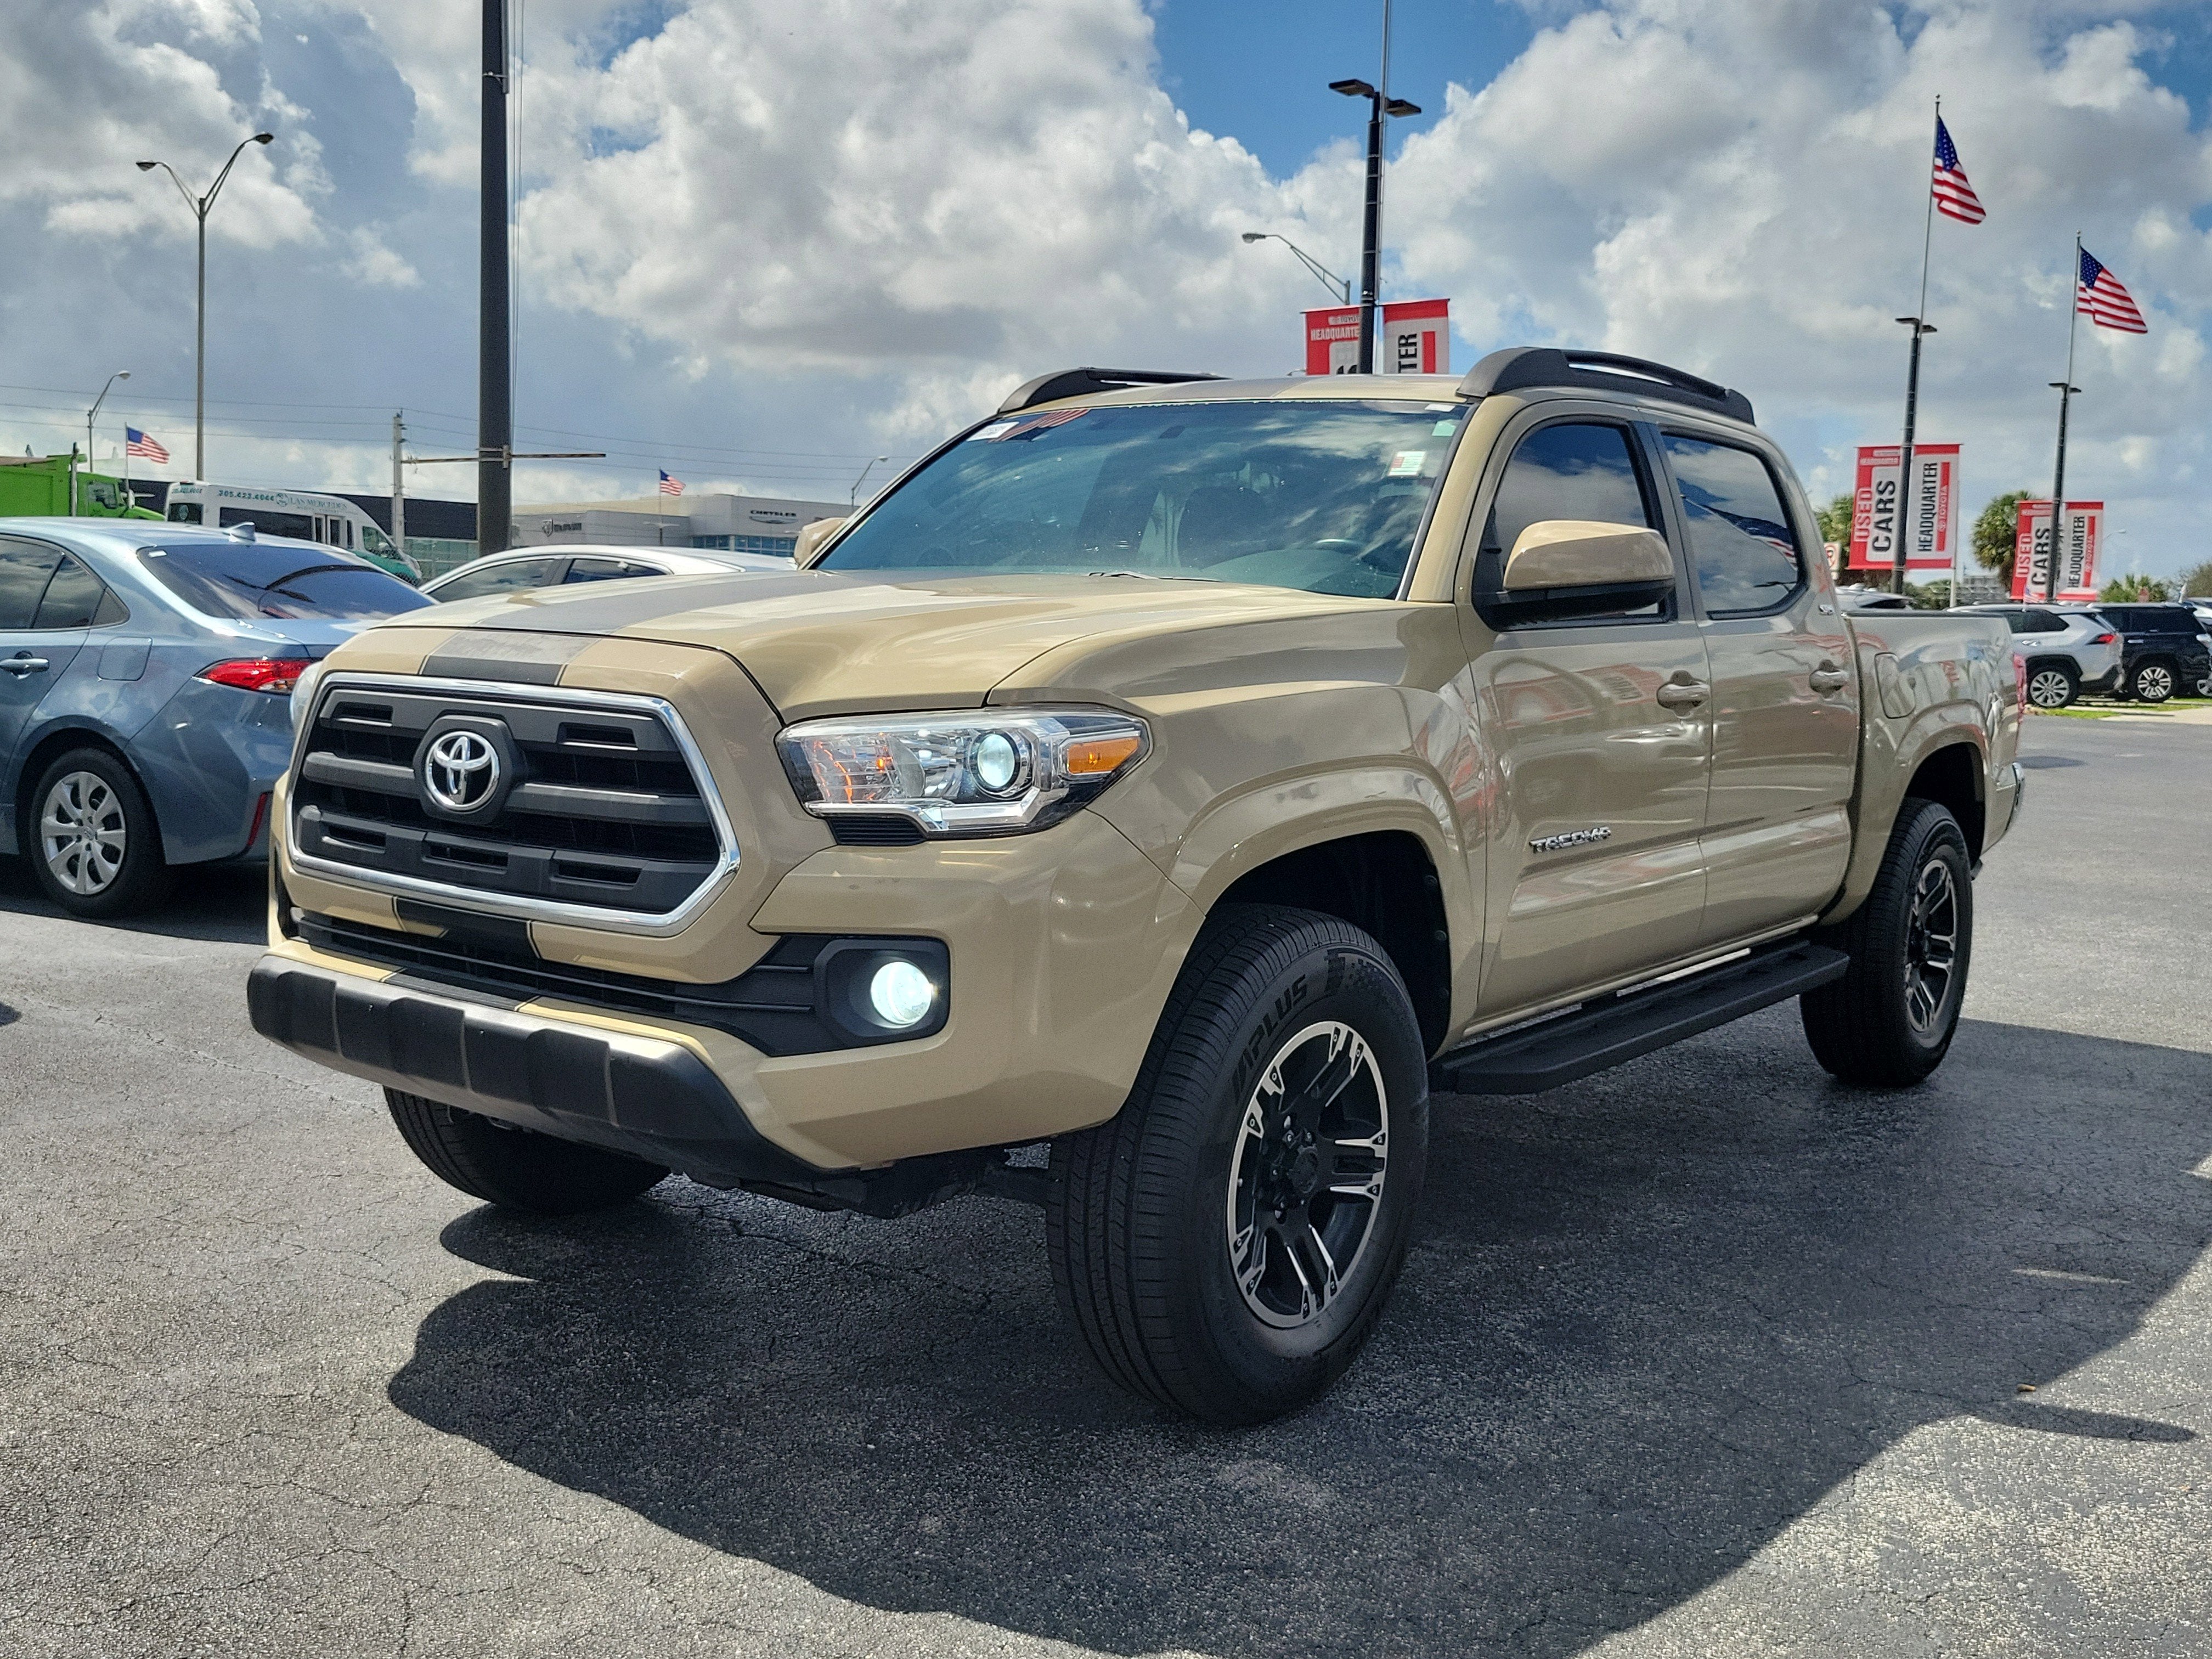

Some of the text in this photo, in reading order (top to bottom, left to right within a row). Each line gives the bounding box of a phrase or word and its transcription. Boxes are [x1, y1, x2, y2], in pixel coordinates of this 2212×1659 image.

[1310, 326, 1360, 341] HEADQUARTE
[1854, 487, 1872, 541] USED
[1872, 481, 1896, 552] CARS
[1918, 462, 1938, 552] HEADQUARTER
[2017, 533, 2032, 577] USED
[2032, 528, 2050, 585] CARS
[2067, 516, 2085, 588] HEADQUARTER
[1529, 826, 1612, 853] TACOMA
